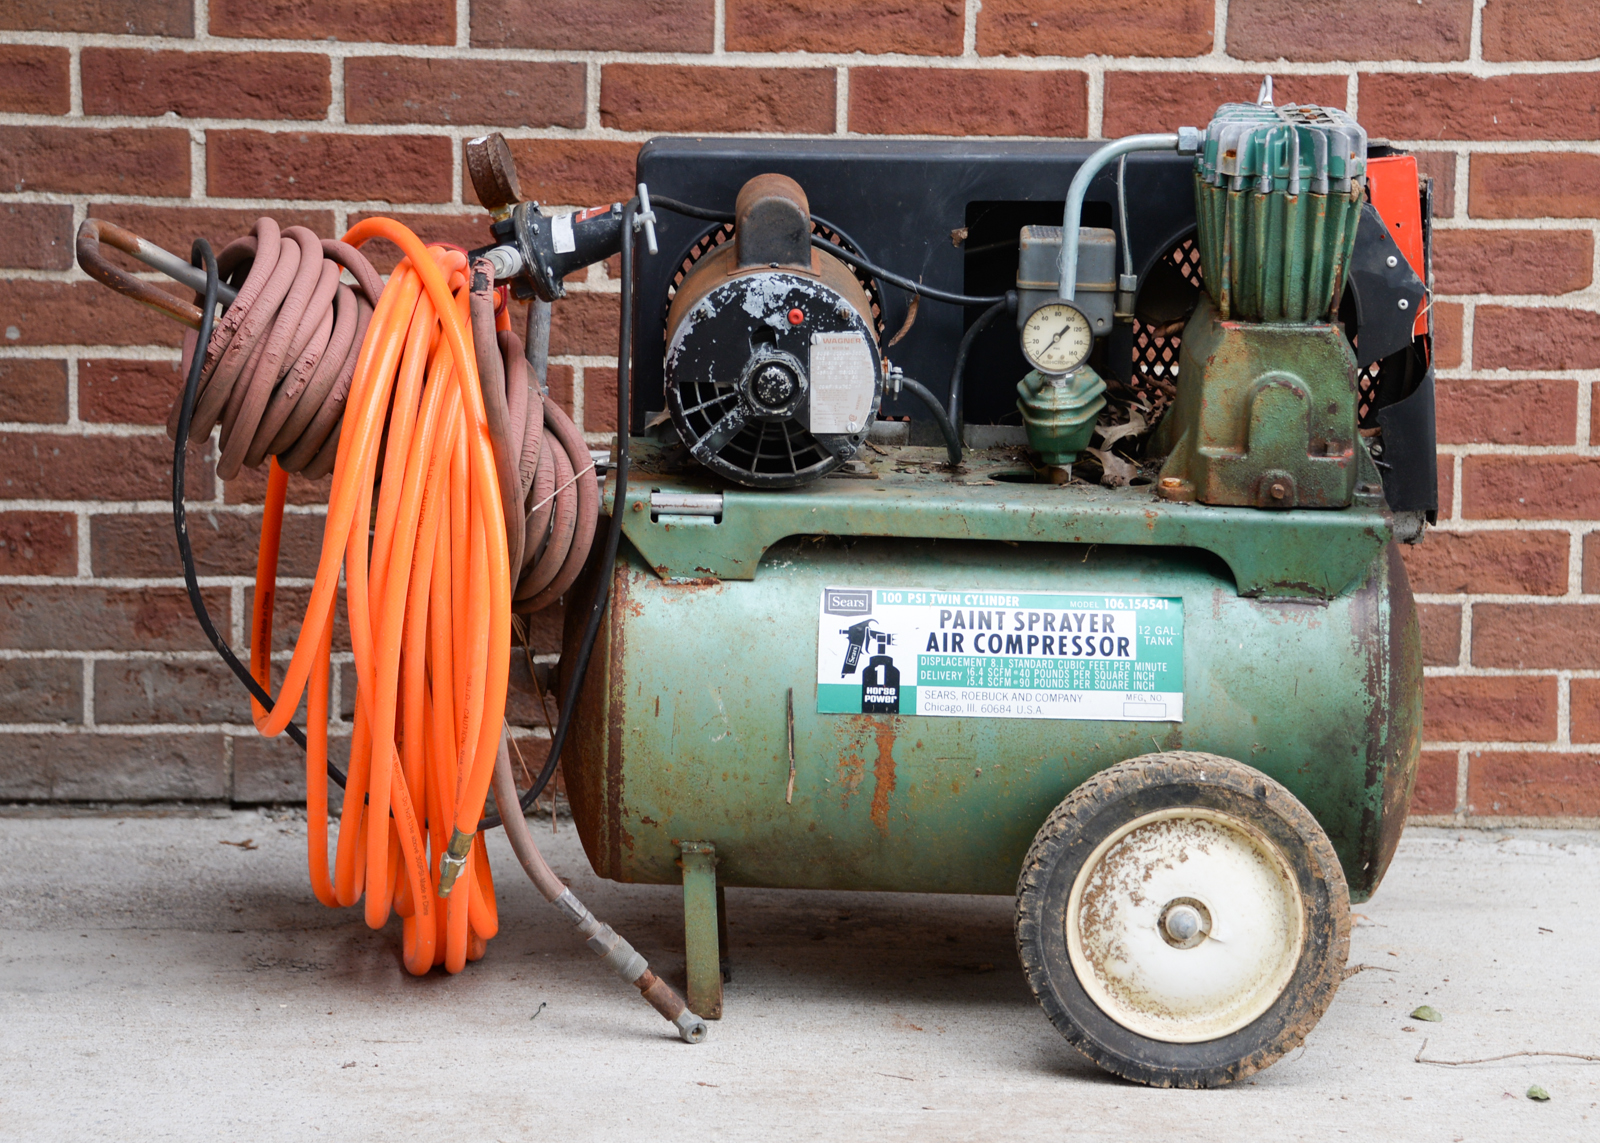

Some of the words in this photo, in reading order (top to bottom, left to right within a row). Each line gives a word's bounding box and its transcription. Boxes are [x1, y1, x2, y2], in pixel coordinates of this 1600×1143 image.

[832, 596, 864, 608] Sears
[882, 593, 902, 603] 100
[908, 593, 926, 604] PSI
[930, 594, 960, 605] TWIN
[964, 594, 1019, 607] CYLINDER
[1104, 598, 1168, 610] 106.154541
[940, 610, 1006, 630] PAINT
[1014, 612, 1115, 633] SPRAYER
[1139, 626, 1150, 634] 12
[1155, 627, 1180, 635] GAL.
[926, 632, 964, 652] AIR
[974, 633, 1129, 657] COMPRESSOR
[1144, 636, 1173, 645] TANK
[921, 657, 986, 667] DISPLACEMENT
[991, 659, 1003, 667] 8.1
[1009, 659, 1053, 669] STANDARD
[1058, 660, 1085, 669] CUBIC
[1089, 661, 1109, 670] FEET
[1114, 662, 1130, 670] PER
[1135, 662, 1167, 672] MINUTE
[875, 665, 885, 685] 1
[921, 670, 962, 680] DELIVERY
[970, 668, 983, 676] 6.4
[988, 668, 1011, 677] SCFM
[1034, 669, 1069, 679] POUNDS
[1074, 670, 1090, 679] PER
[1095, 671, 1129, 680] SQUARE
[1134, 672, 1154, 680] INCH
[970, 677, 983, 686] 5.4
[988, 678, 1011, 687] SCFM
[1034, 678, 1069, 688] POUNDS
[1074, 680, 1090, 689] PER
[1095, 680, 1129, 690] SQUARE
[1134, 681, 1154, 690] INCH
[925, 690, 958, 701] SEARS,
[962, 691, 1008, 701] ROEBUCK
[1011, 693, 1032, 702] AND
[1035, 693, 1083, 703] COMPANY
[1150, 694, 1164, 702] NO.
[924, 702, 964, 713] Chicago,
[967, 703, 977, 713] Ill.
[981, 704, 1011, 713] 60684
[1016, 705, 1044, 714] U.S.A.
[402, 797, 408, 806] Do
[411, 835, 419, 854] above
